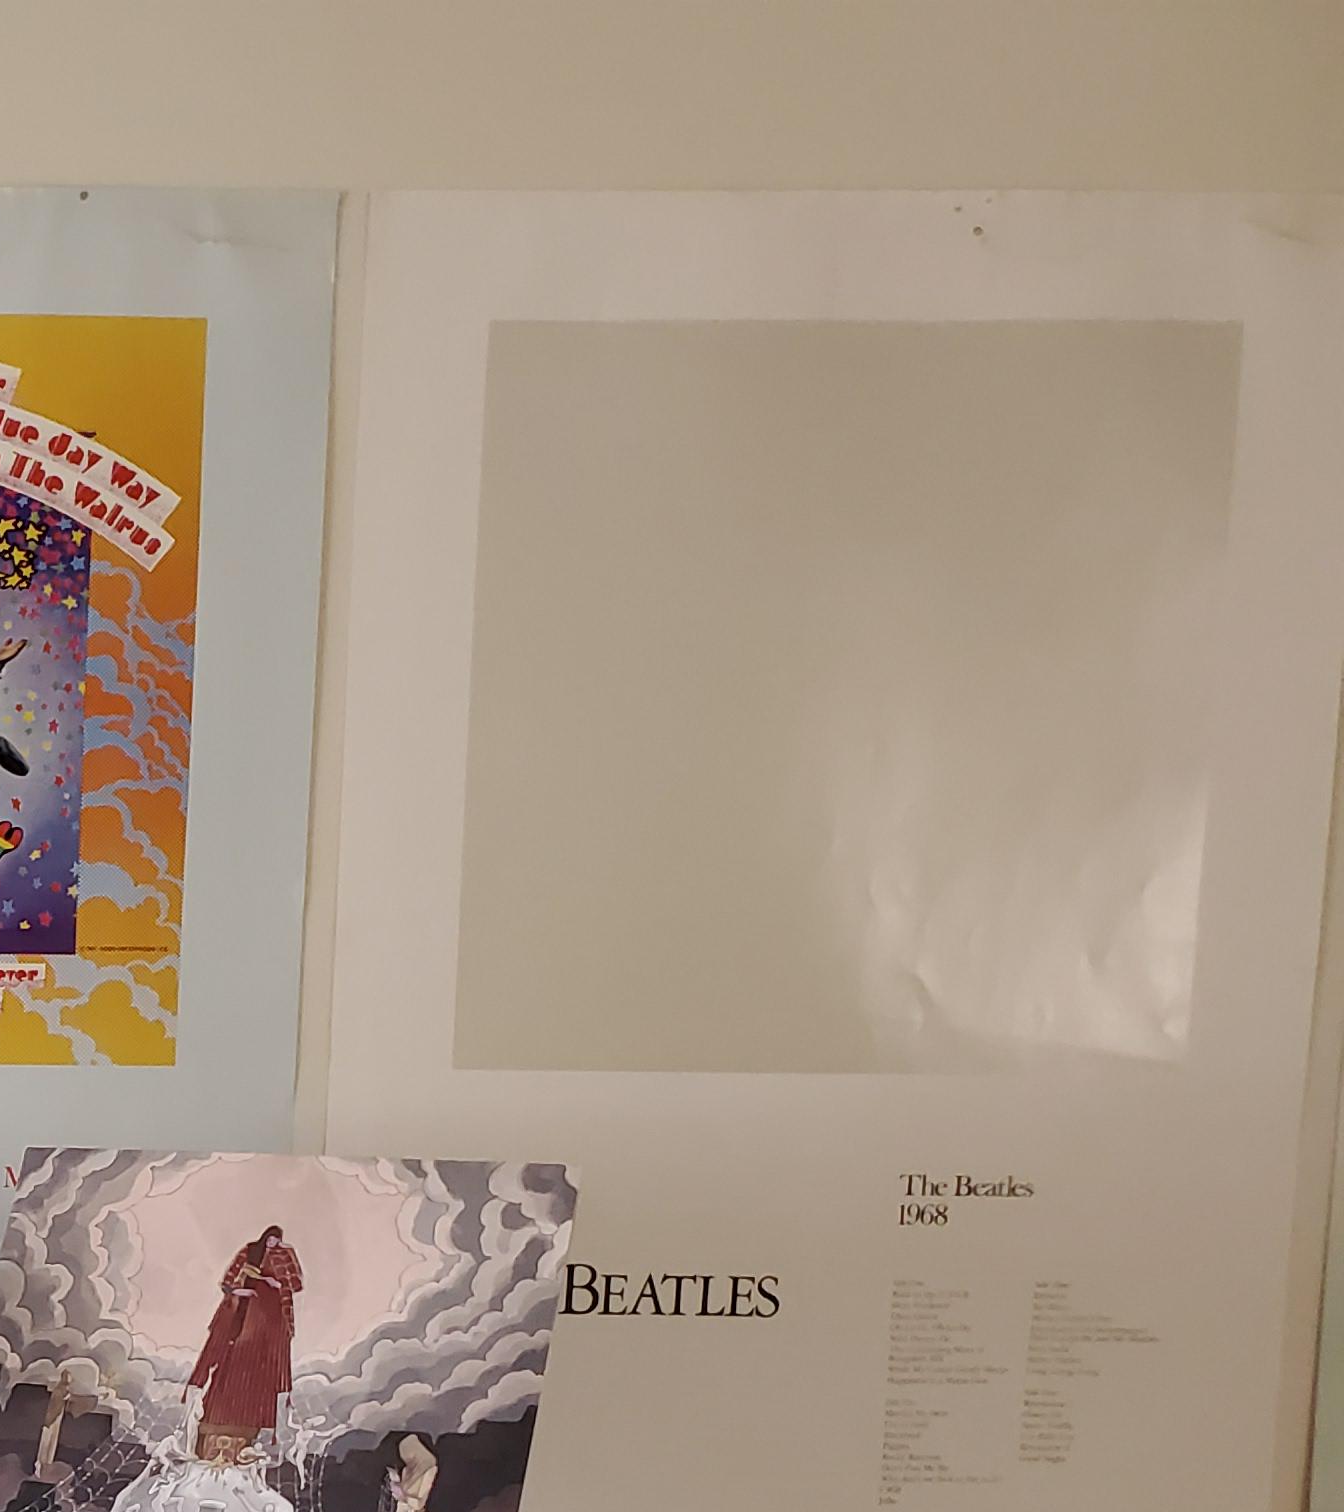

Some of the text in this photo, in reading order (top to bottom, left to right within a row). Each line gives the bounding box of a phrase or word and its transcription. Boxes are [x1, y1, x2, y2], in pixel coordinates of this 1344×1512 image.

[9, 452, 64, 494] The
[75, 481, 161, 555] Walrus
[111, 461, 160, 508] Way
[900, 1174, 1035, 1199] The Beatles
[898, 1203, 950, 1226] 1968
[561, 1264, 781, 1319] BEATLES
